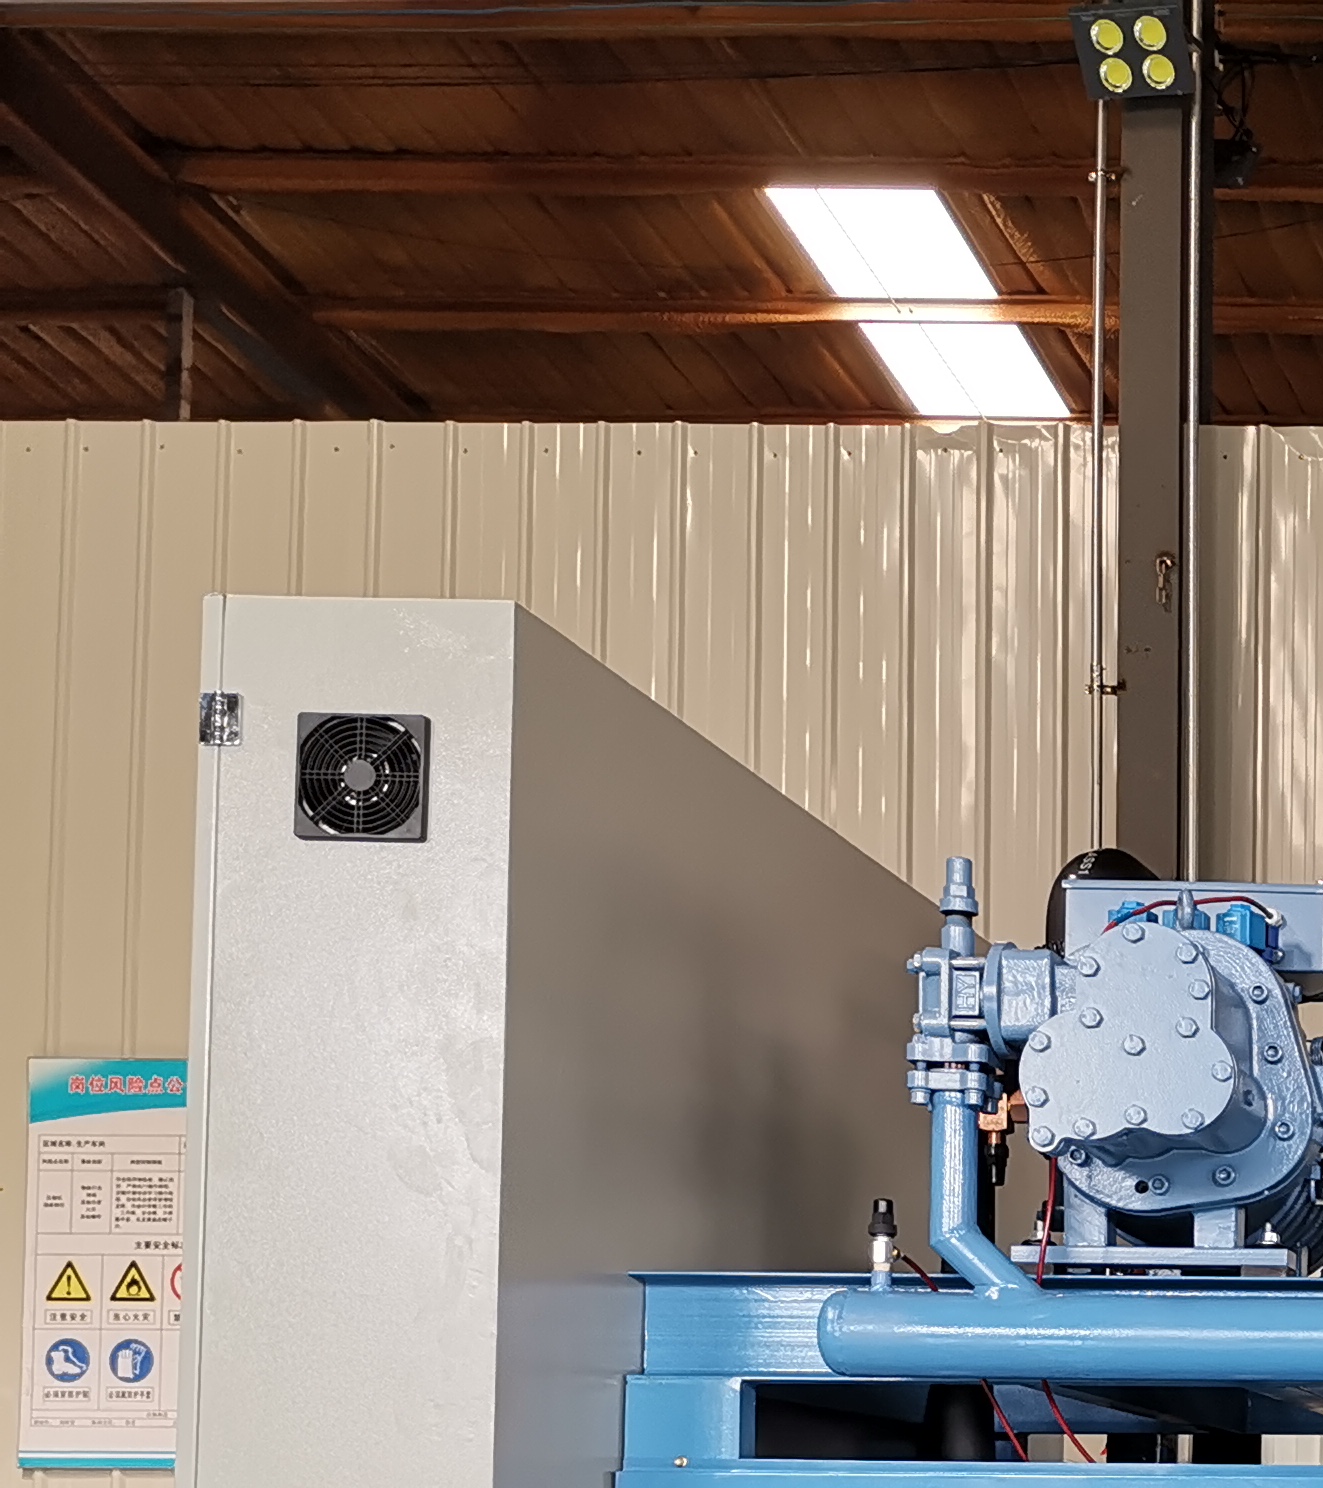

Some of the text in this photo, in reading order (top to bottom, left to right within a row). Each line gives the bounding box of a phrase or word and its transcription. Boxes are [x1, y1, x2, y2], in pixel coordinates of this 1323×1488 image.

[68, 1074, 184, 1095] 岗位风险点公
